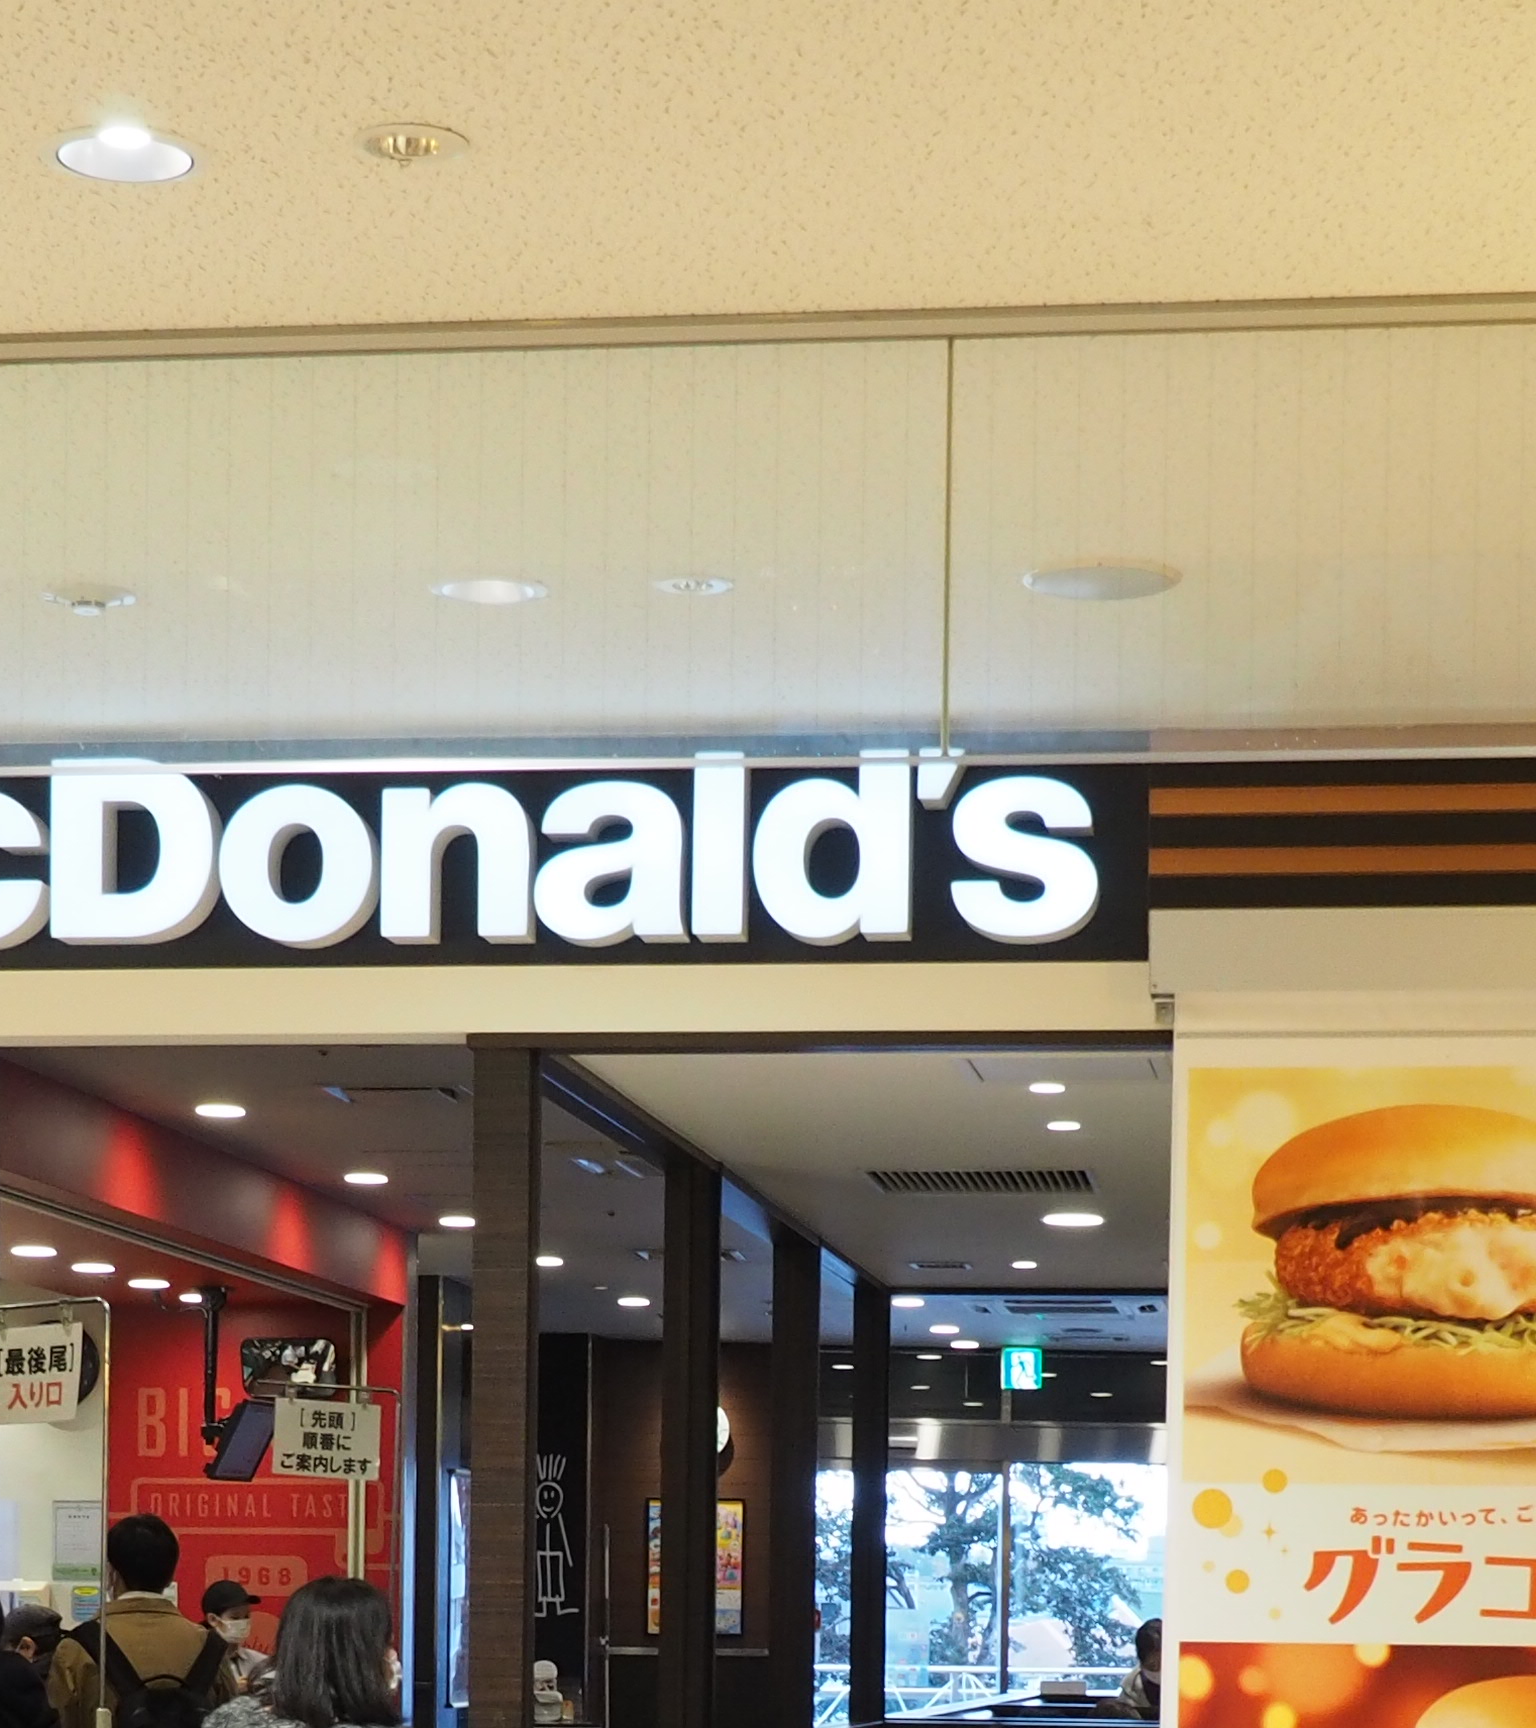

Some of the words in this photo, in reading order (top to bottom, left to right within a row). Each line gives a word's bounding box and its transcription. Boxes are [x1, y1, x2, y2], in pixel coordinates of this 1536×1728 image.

[7, 1382, 63, 1410] 入り口
[302, 1431, 352, 1452] 順番に
[280, 1452, 372, 1476] ご案内します
[149, 1492, 272, 1518] ORIGINAL
[289, 1492, 349, 1518] TAST
[221, 1565, 292, 1586] 1968
